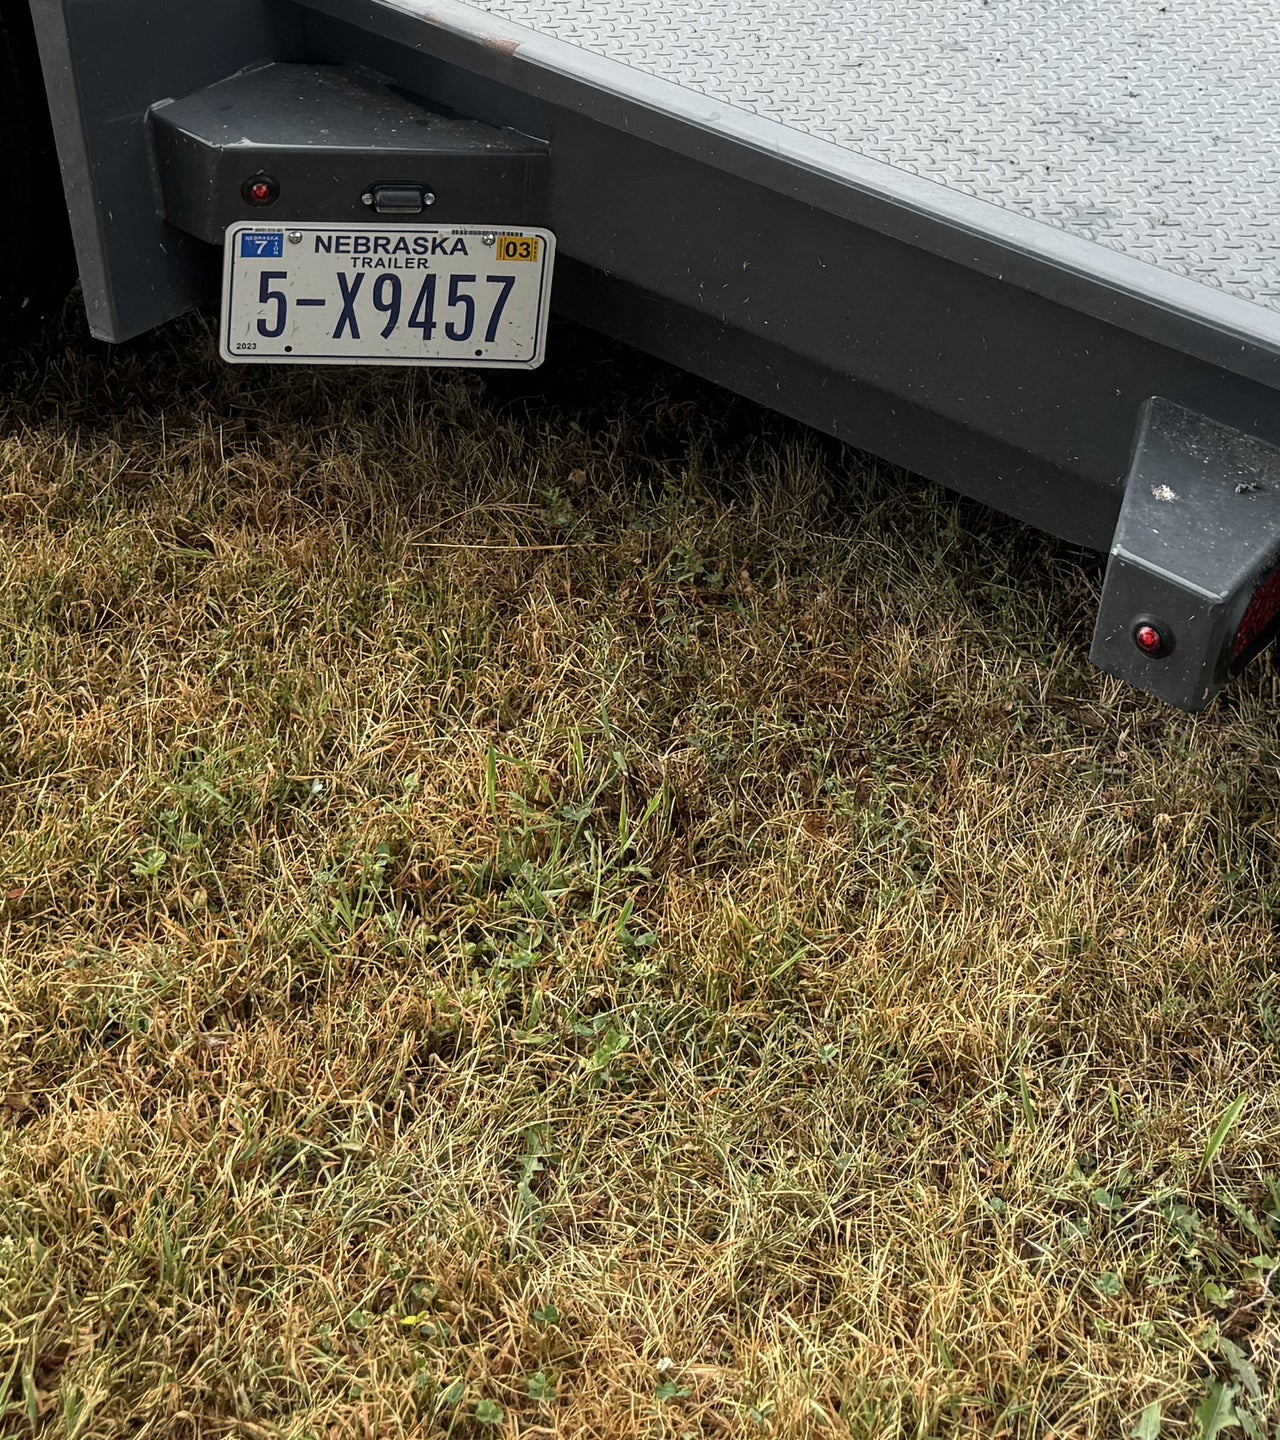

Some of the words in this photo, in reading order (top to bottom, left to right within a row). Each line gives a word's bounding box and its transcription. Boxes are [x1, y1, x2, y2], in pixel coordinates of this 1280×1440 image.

[255, 240, 268, 255] 7
[314, 235, 469, 256] NEBRASKA
[505, 241, 531, 258] 03
[350, 257, 430, 269] TRAILER
[256, 271, 516, 342] 5-X9457
[236, 342, 257, 350] 2023
